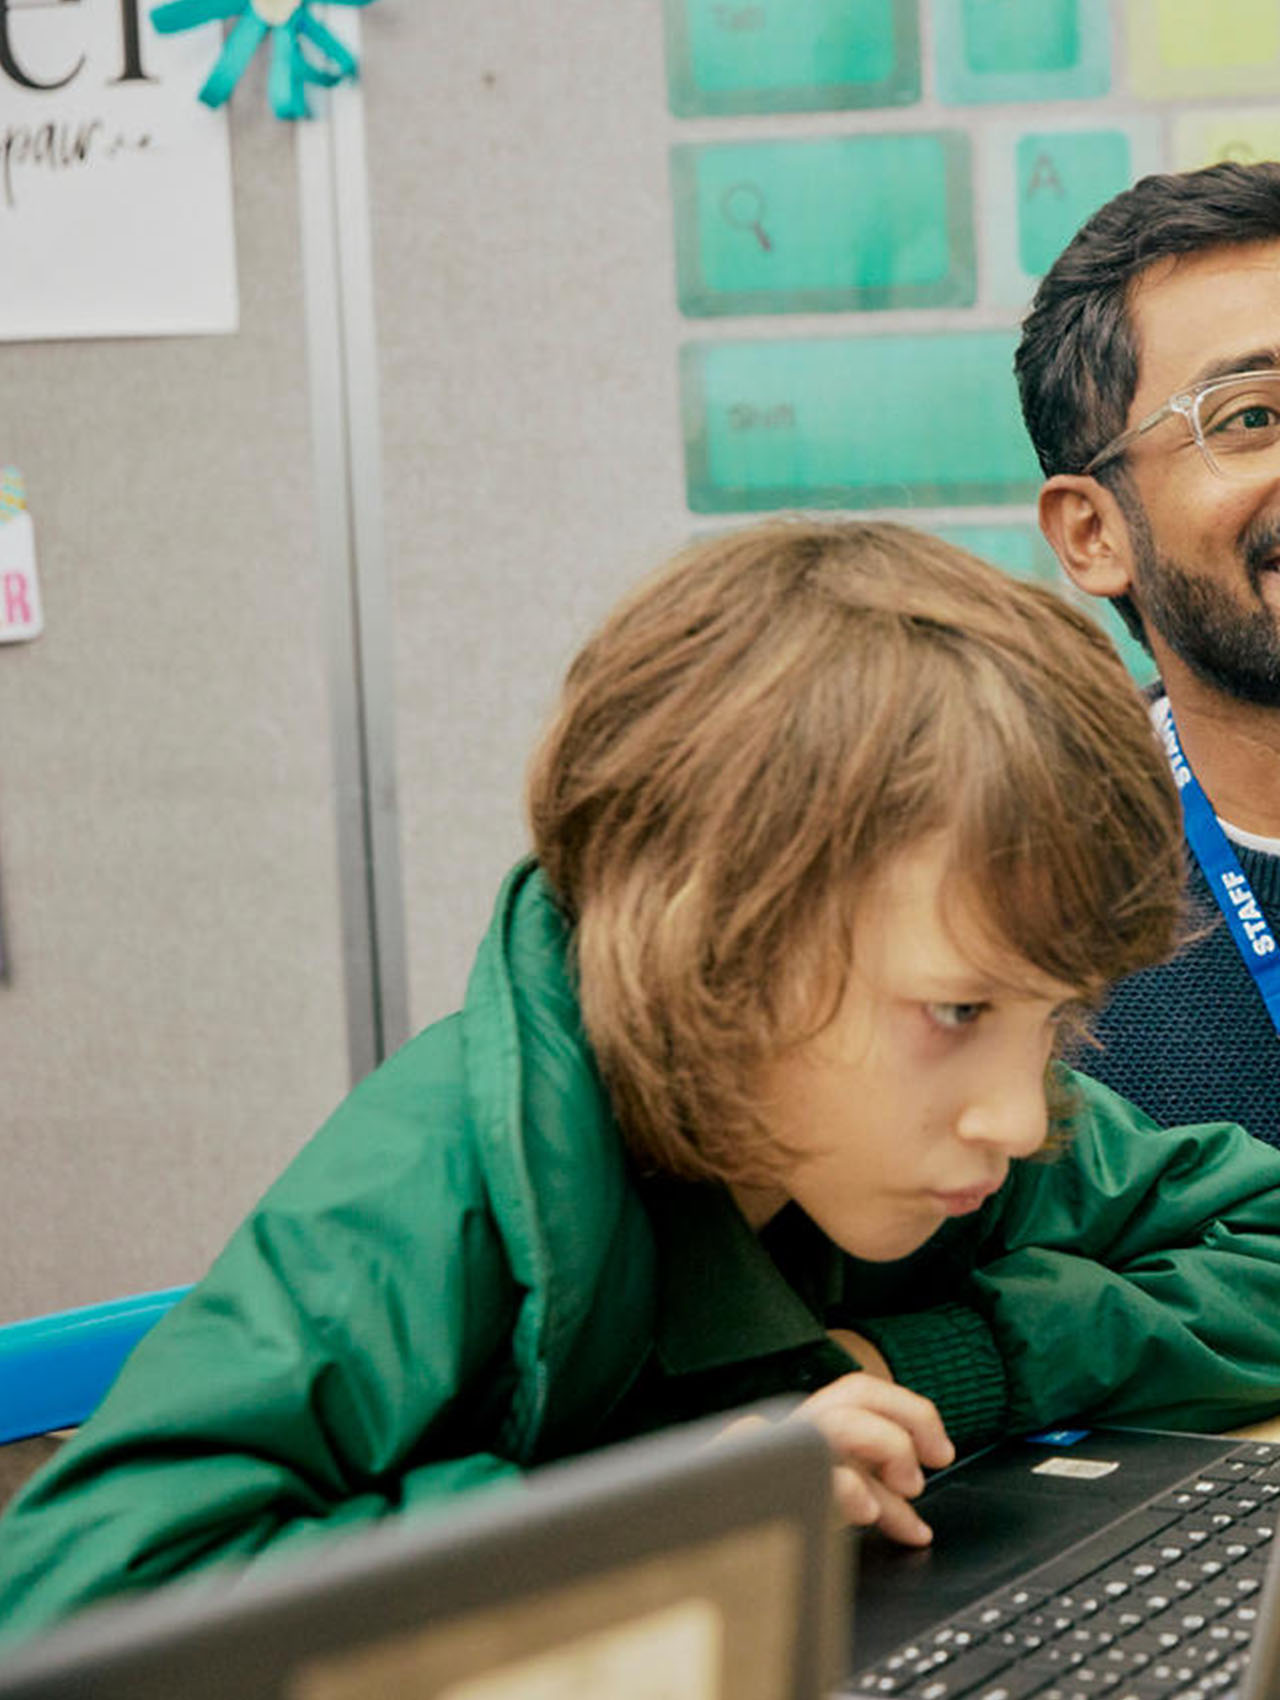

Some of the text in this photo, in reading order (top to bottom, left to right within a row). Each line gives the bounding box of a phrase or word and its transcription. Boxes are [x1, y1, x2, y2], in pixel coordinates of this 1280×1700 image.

[1027, 153, 1066, 202] A
[4, 571, 31, 624] R
[1221, 871, 1276, 957] STAFF
